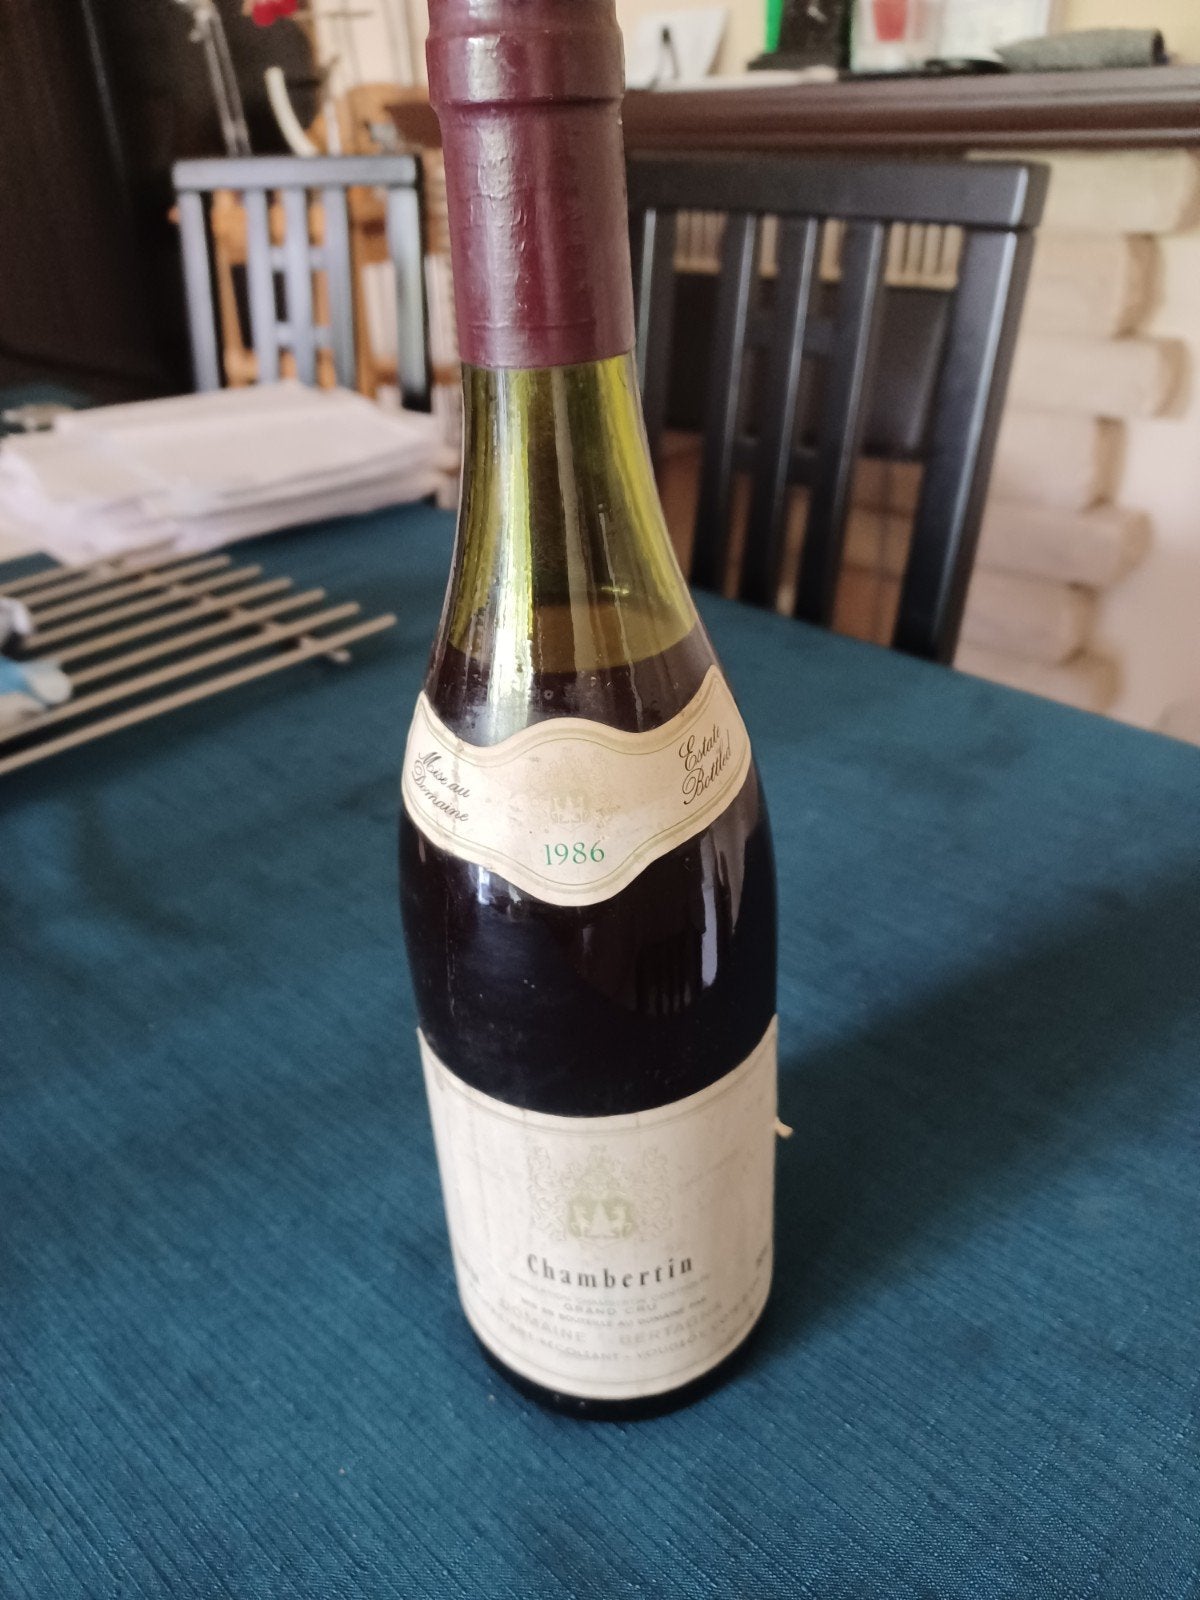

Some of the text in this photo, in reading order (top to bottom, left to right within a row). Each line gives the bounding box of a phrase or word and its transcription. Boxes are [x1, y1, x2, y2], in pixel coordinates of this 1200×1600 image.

[678, 723, 720, 772] Estate
[682, 728, 732, 805] Bottled
[411, 759, 469, 822] Domaine
[418, 751, 471, 798] Mise au
[544, 839, 605, 866] 1986
[527, 1253, 692, 1289] Chambertin
